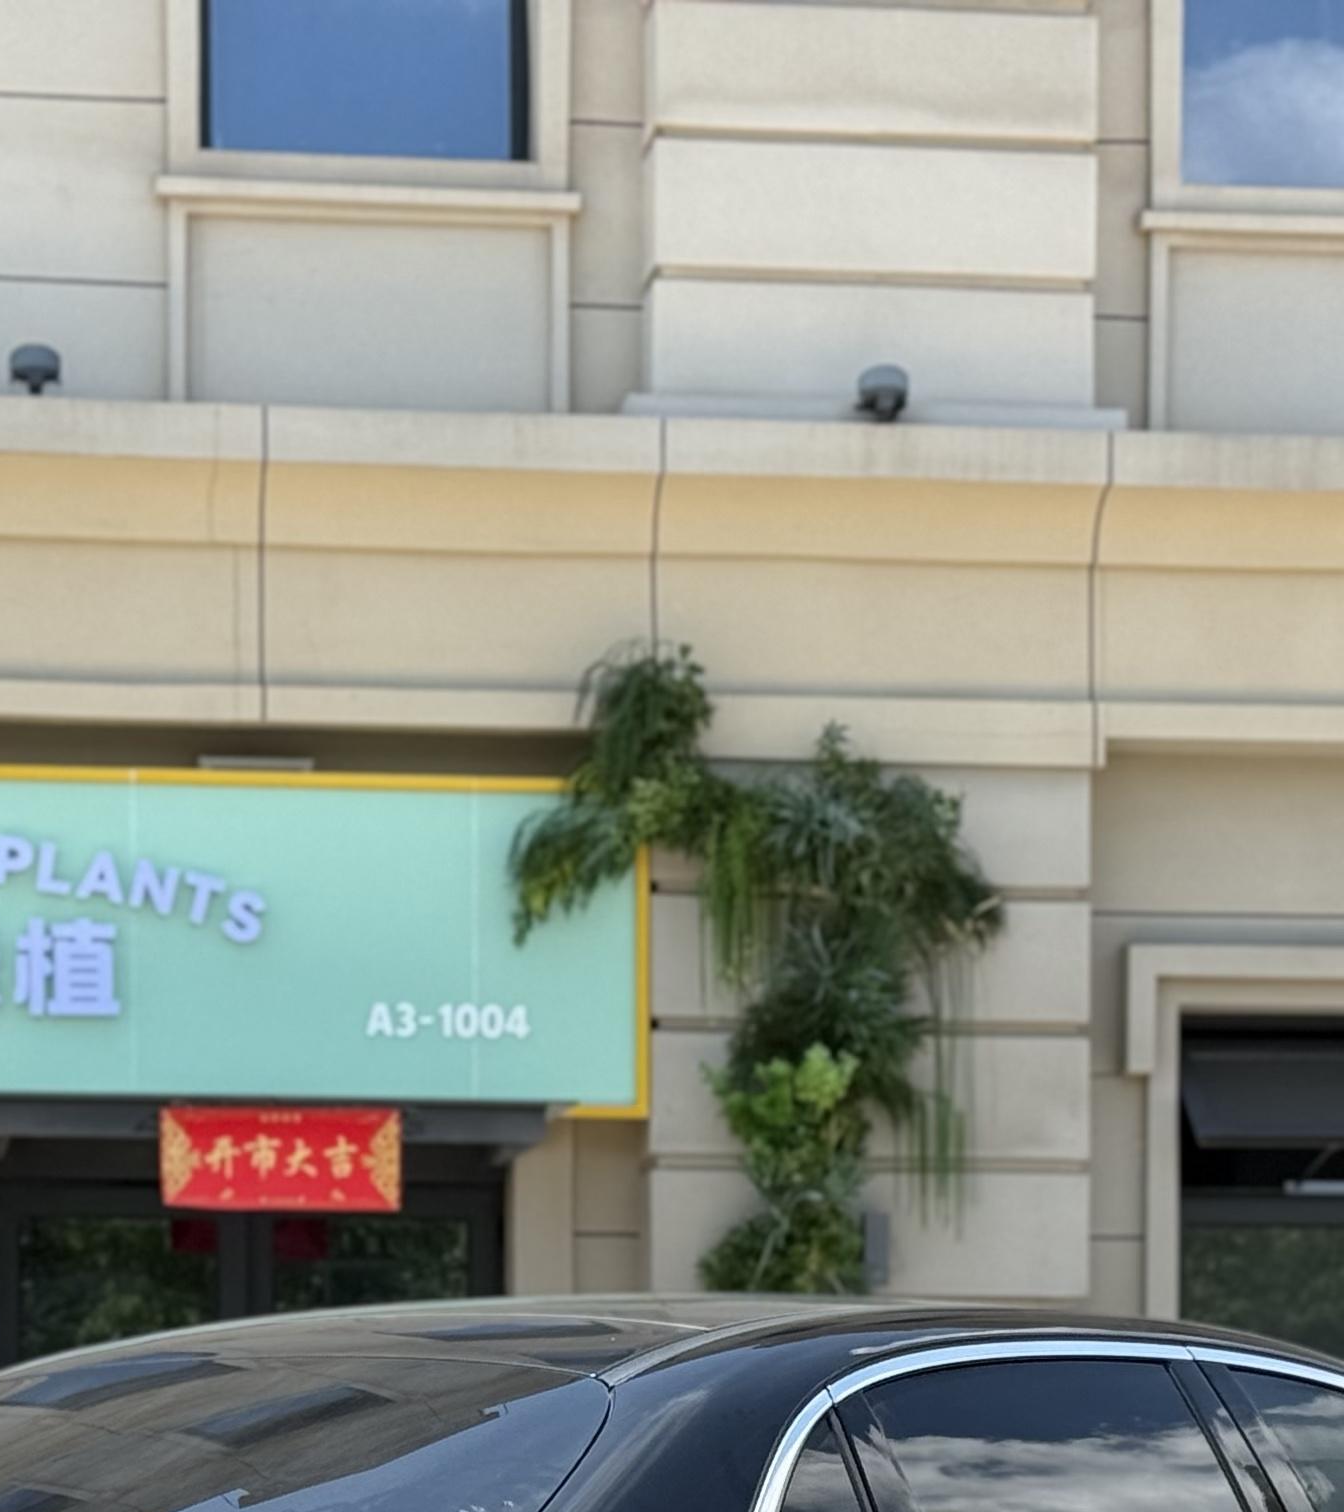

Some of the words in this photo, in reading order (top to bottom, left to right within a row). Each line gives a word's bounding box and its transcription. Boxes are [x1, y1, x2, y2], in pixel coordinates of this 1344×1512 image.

[365, 1001, 532, 1039] A3-1004
[204, 1132, 360, 1181] 开市大吉
